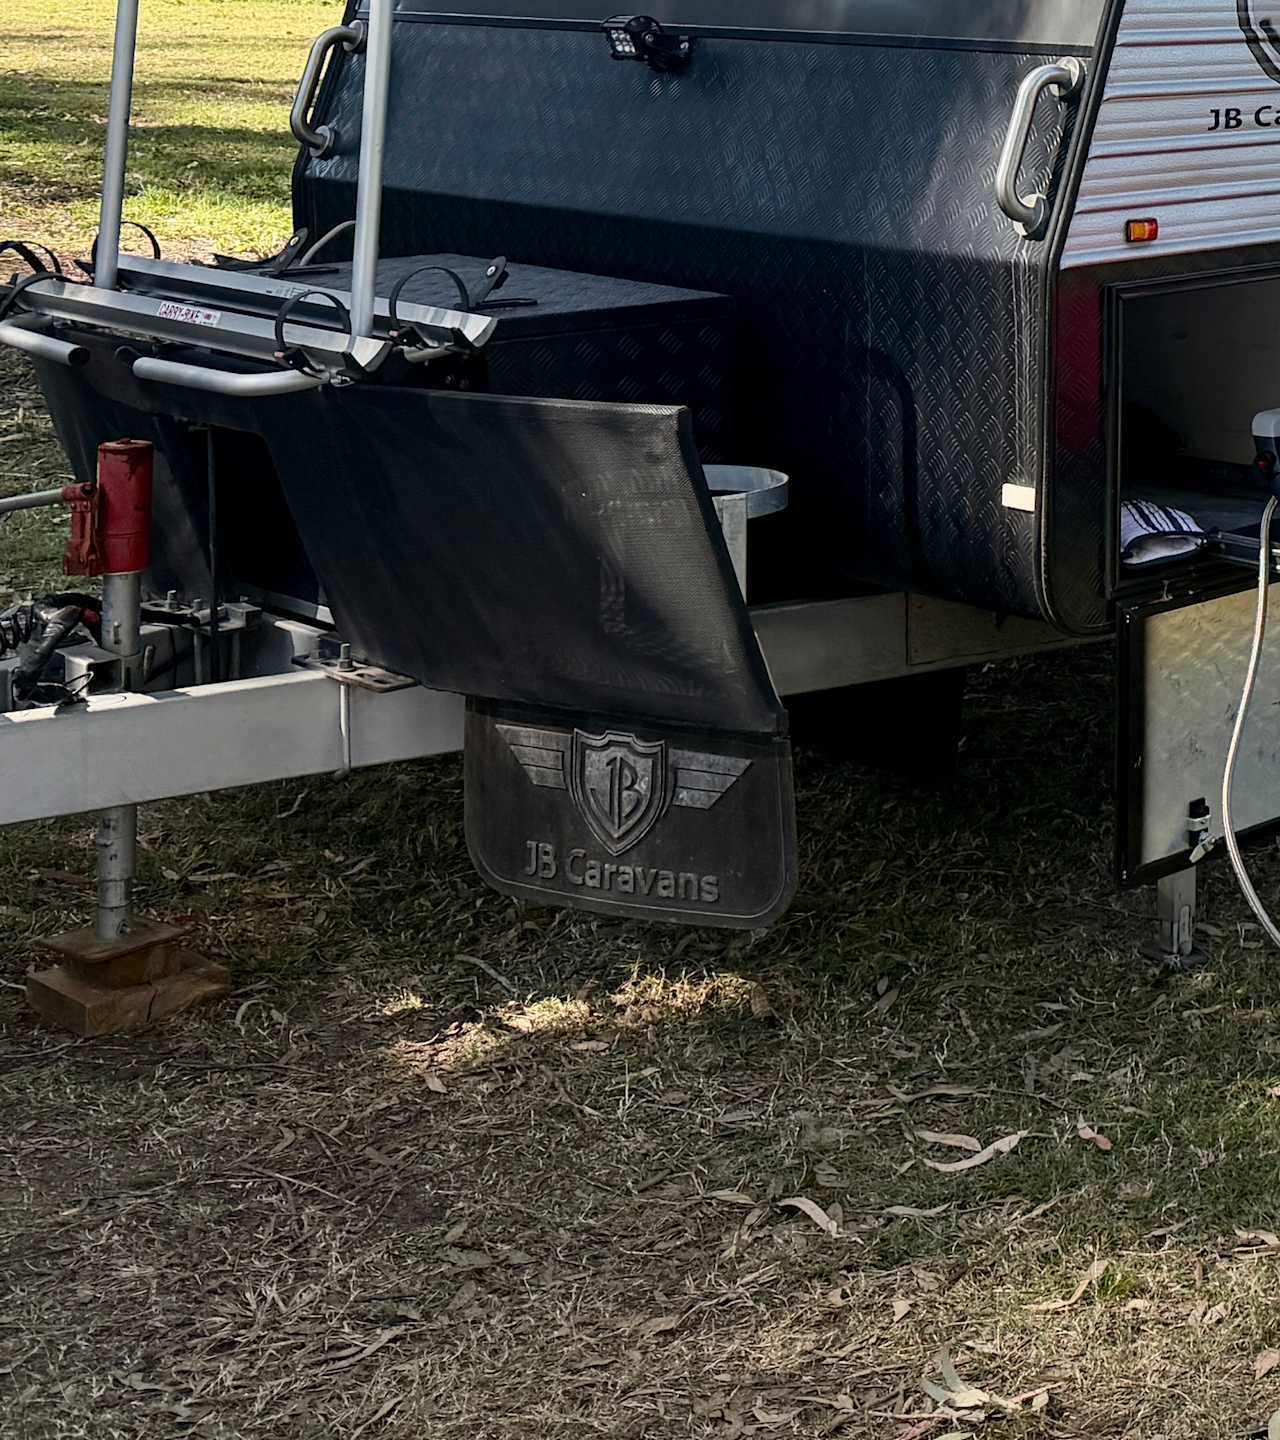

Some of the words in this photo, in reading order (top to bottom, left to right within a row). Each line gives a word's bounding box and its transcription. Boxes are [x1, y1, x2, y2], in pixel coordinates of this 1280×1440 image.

[1207, 107, 1243, 131] JB
[526, 840, 557, 879] JB
[566, 847, 720, 903] Caravans
